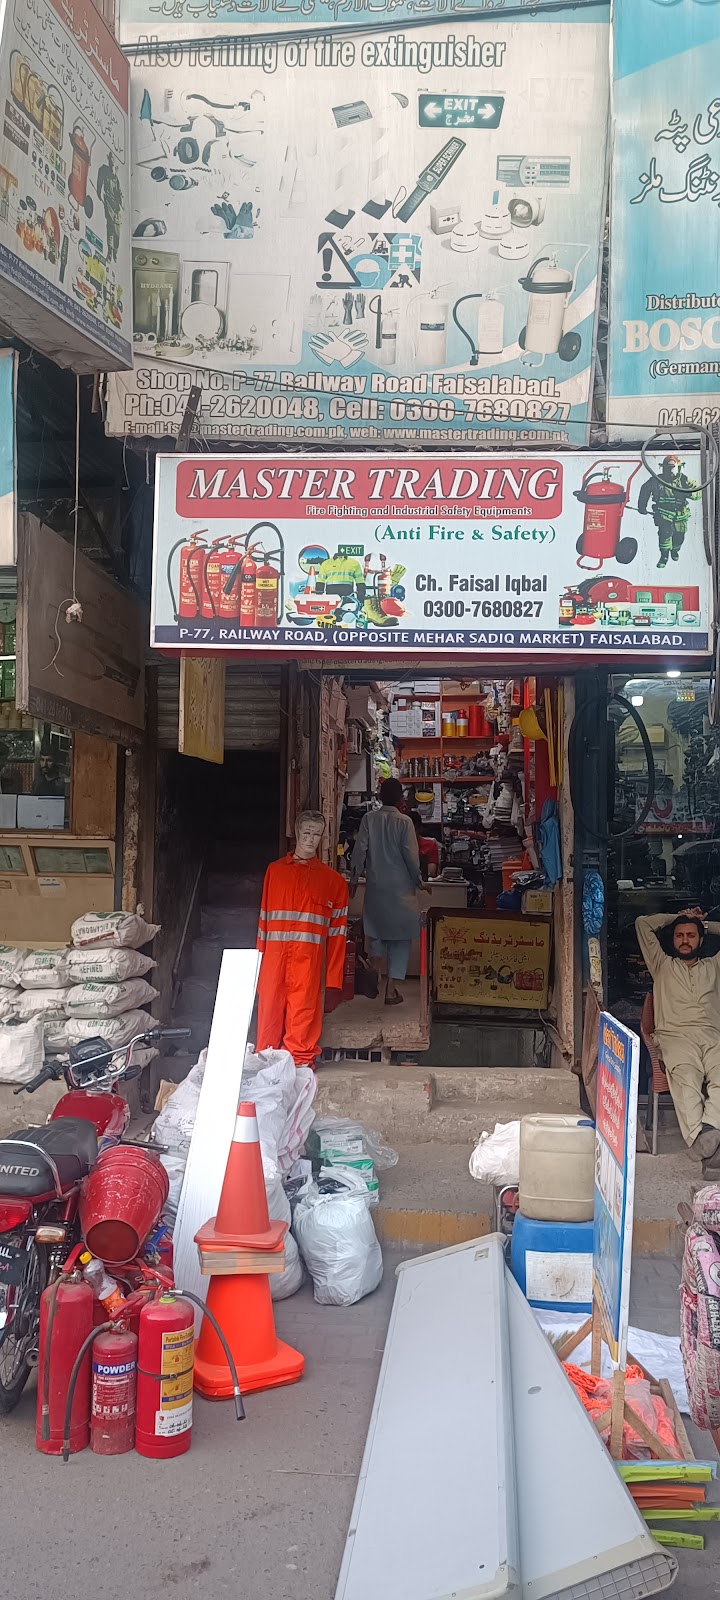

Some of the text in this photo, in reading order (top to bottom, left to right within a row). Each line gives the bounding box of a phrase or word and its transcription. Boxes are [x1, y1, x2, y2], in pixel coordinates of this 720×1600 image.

[134, 35, 506, 74] Also refilling of fire extinguisher
[444, 98, 479, 110] EXIT
[445, 112, 475, 126] مخرج
[655, 109, 691, 153] پٹہ
[630, 157, 663, 204] ملز
[136, 369, 561, 397] Shop No. P-77 Railway Road Faisalabad.
[124, 394, 571, 425] Ph:04-2620048, Cell: 0300-7680827
[124, 421, 569, 442] E-mail:fs@mastertrading.com.pk, web: www.mastertrading.com.pk
[187, 467, 560, 500] MASTER TRADING
[305, 505, 532, 519] Fire Fighting and Industrial Safety Equipments
[374, 524, 556, 544] (Anti Fire & Safety)
[345, 546, 362, 555] EXIT
[415, 574, 548, 596] Ch. Faisal Iqbal
[423, 600, 544, 618] 0300-7680827
[179, 628, 687, 647] P-77, RAILWAY ROAD, (OPPOSITE MEHAR SADIQ MARKET) FAISALABAD.
[0, 1164, 40, 1177] NITED
[97, 1361, 136, 1374] POWDER
